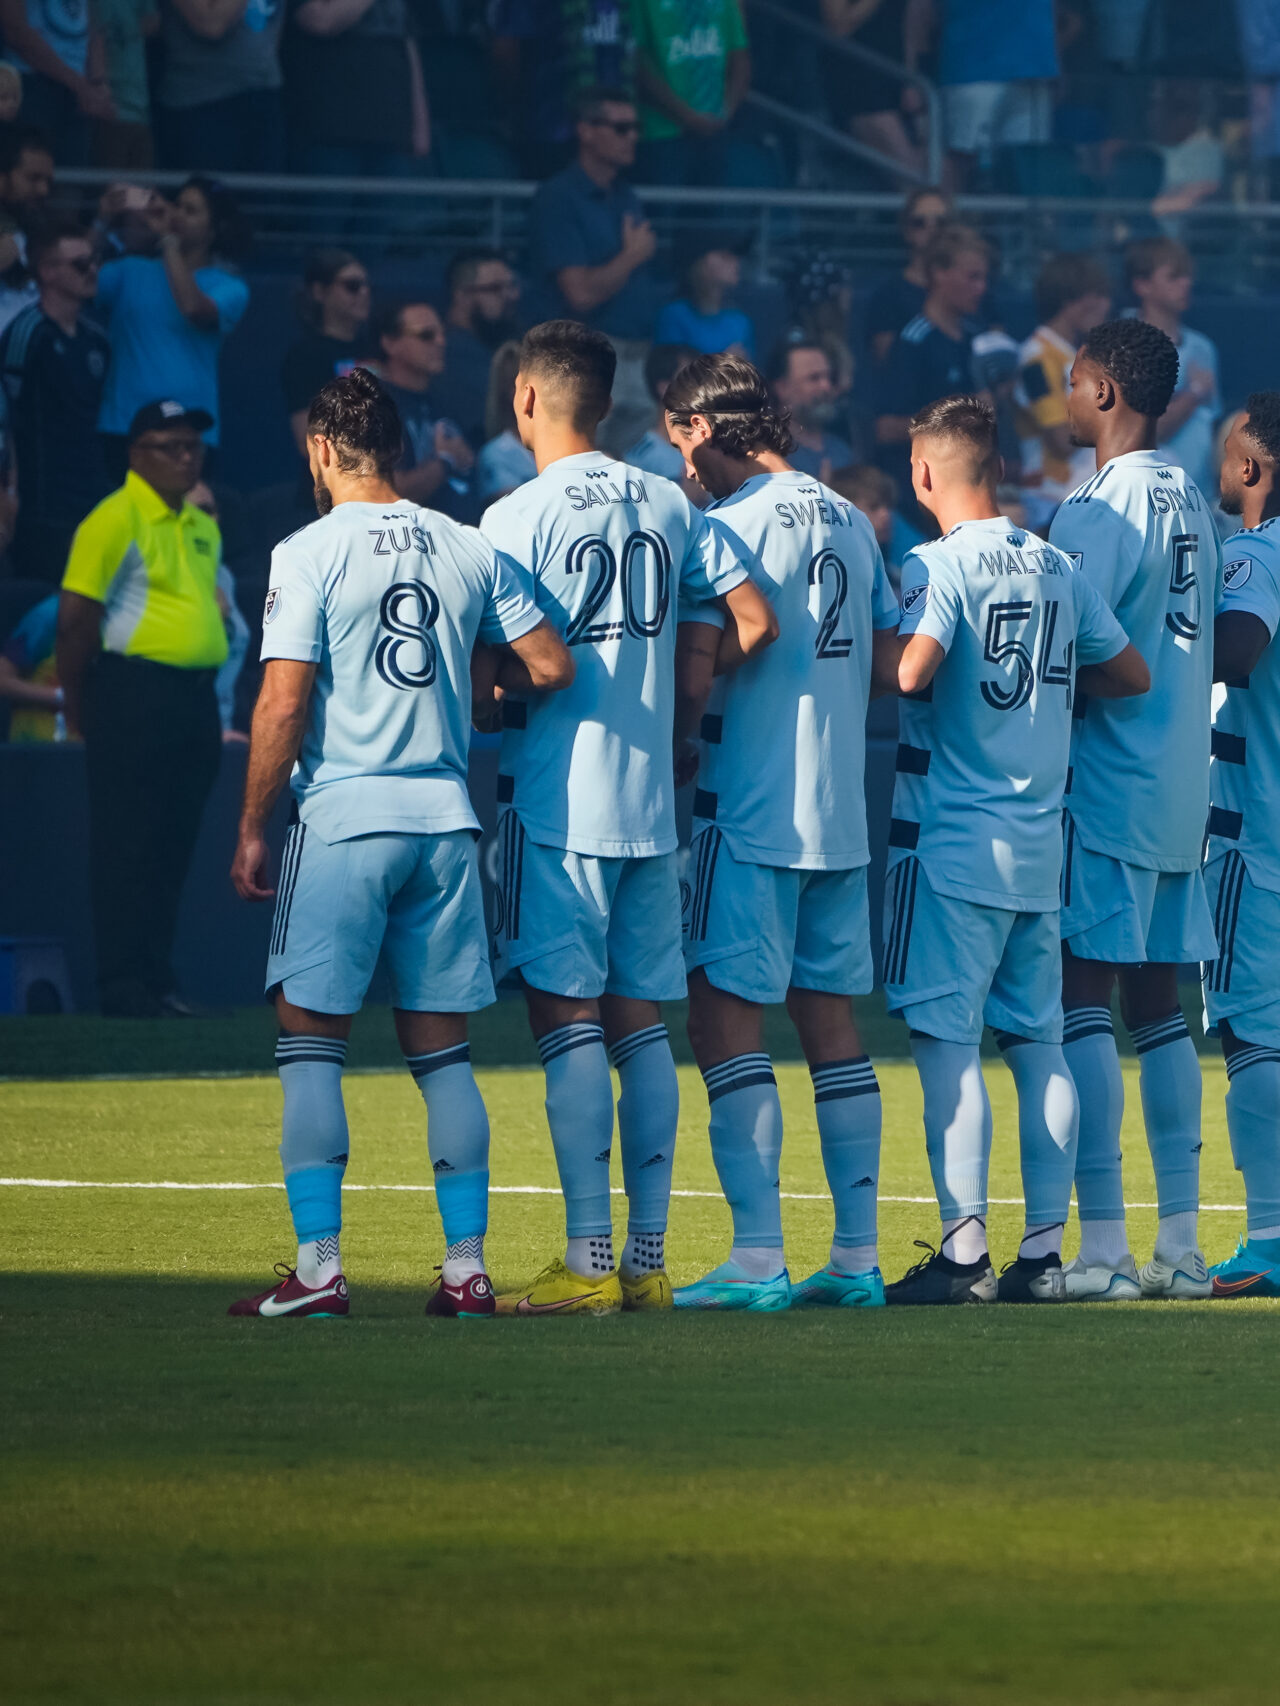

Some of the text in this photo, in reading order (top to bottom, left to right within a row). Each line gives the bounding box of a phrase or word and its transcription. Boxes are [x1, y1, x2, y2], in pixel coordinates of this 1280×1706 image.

[368, 526, 437, 556] ZUSI
[775, 499, 853, 528] SWEAT
[979, 549, 1064, 577] WALTER
[375, 578, 440, 692] 8
[565, 528, 671, 646] 20
[808, 547, 853, 660] 2
[1166, 534, 1202, 641] 5
[980, 600, 1074, 711] 54
